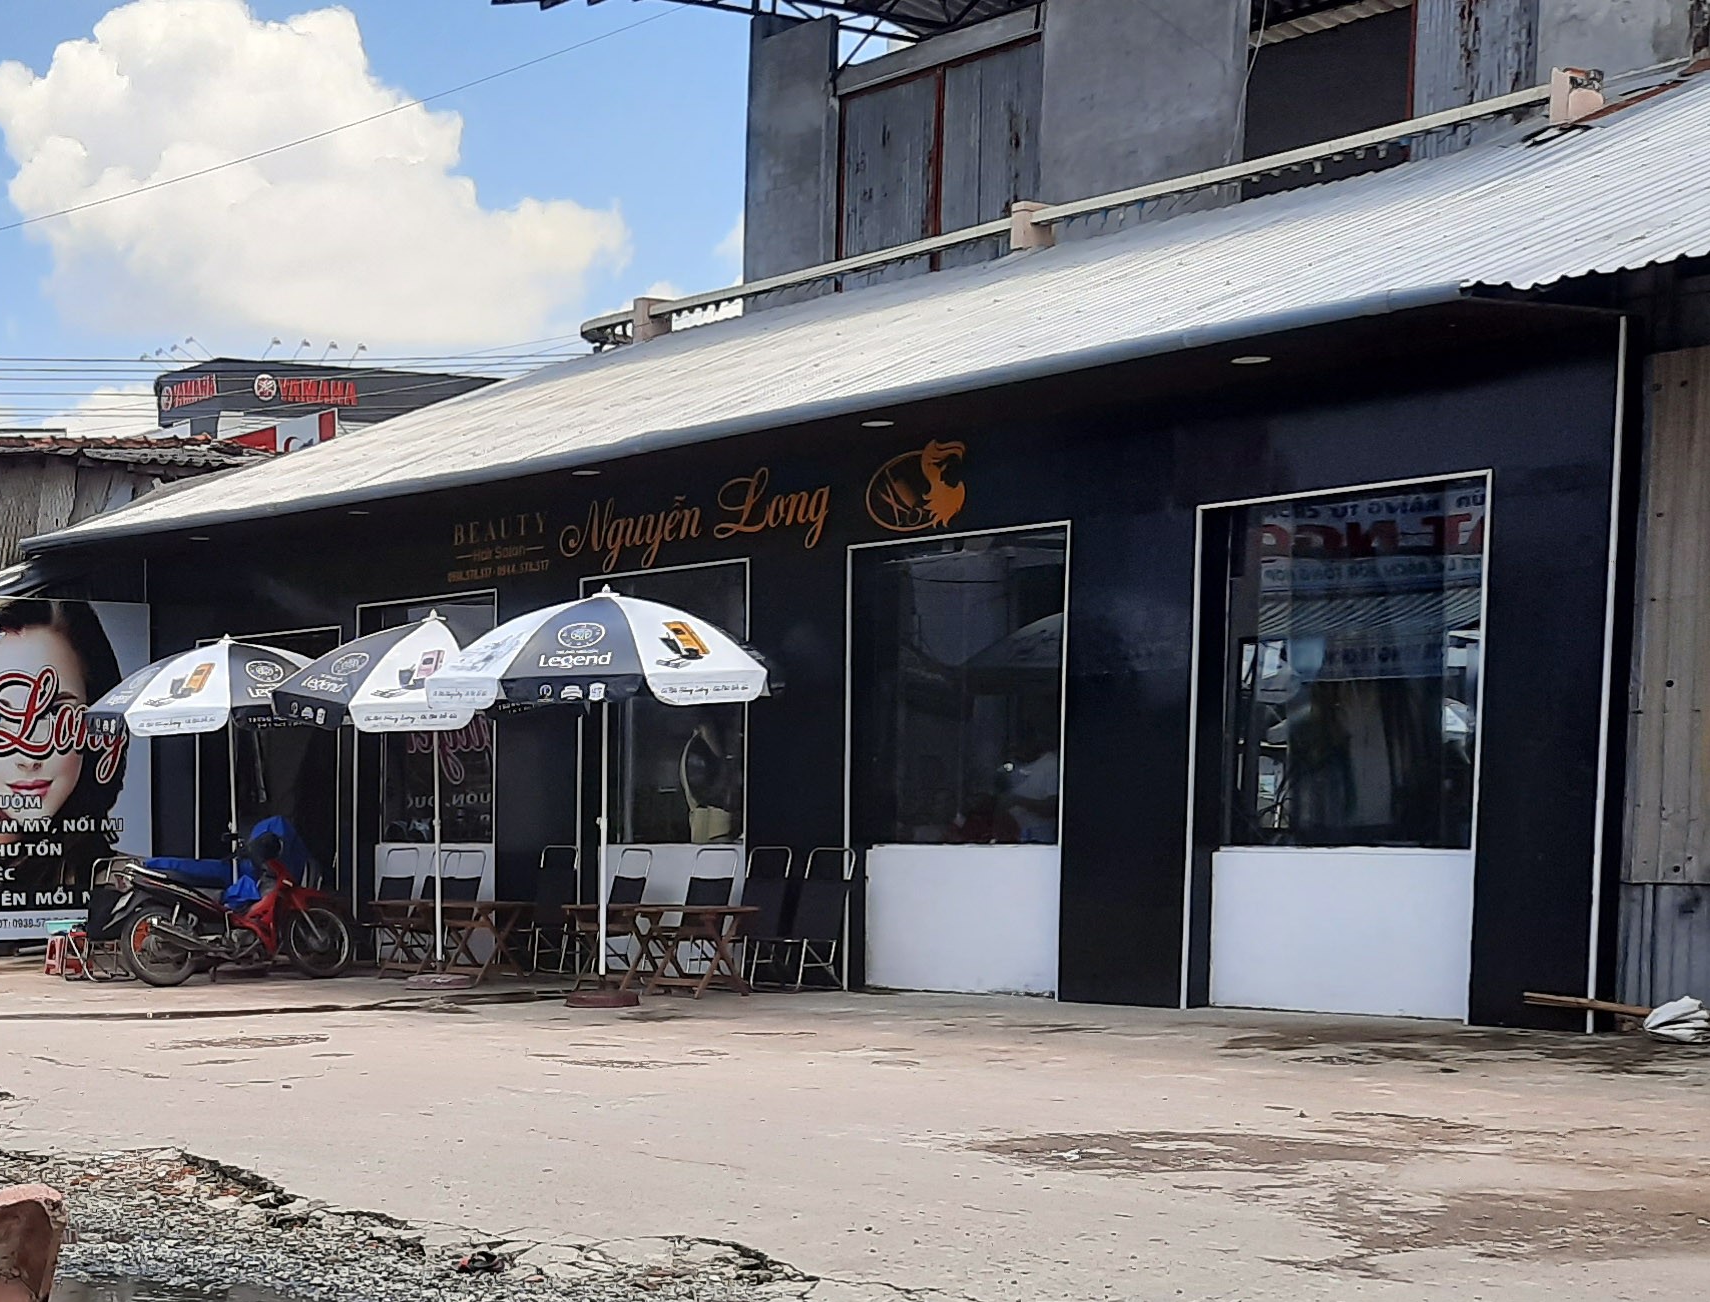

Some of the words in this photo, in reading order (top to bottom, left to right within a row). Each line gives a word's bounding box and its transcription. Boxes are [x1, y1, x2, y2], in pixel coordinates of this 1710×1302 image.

[174, 373, 217, 408] YAMAHA
[278, 378, 358, 406] YAMAHA
[453, 511, 549, 546] BEAUTY
[559, 495, 702, 574] Nguyễn
[713, 467, 831, 549] Long
[539, 652, 612, 669] Legend
[300, 675, 348, 693] Legend
[101, 818, 123, 832] MI
